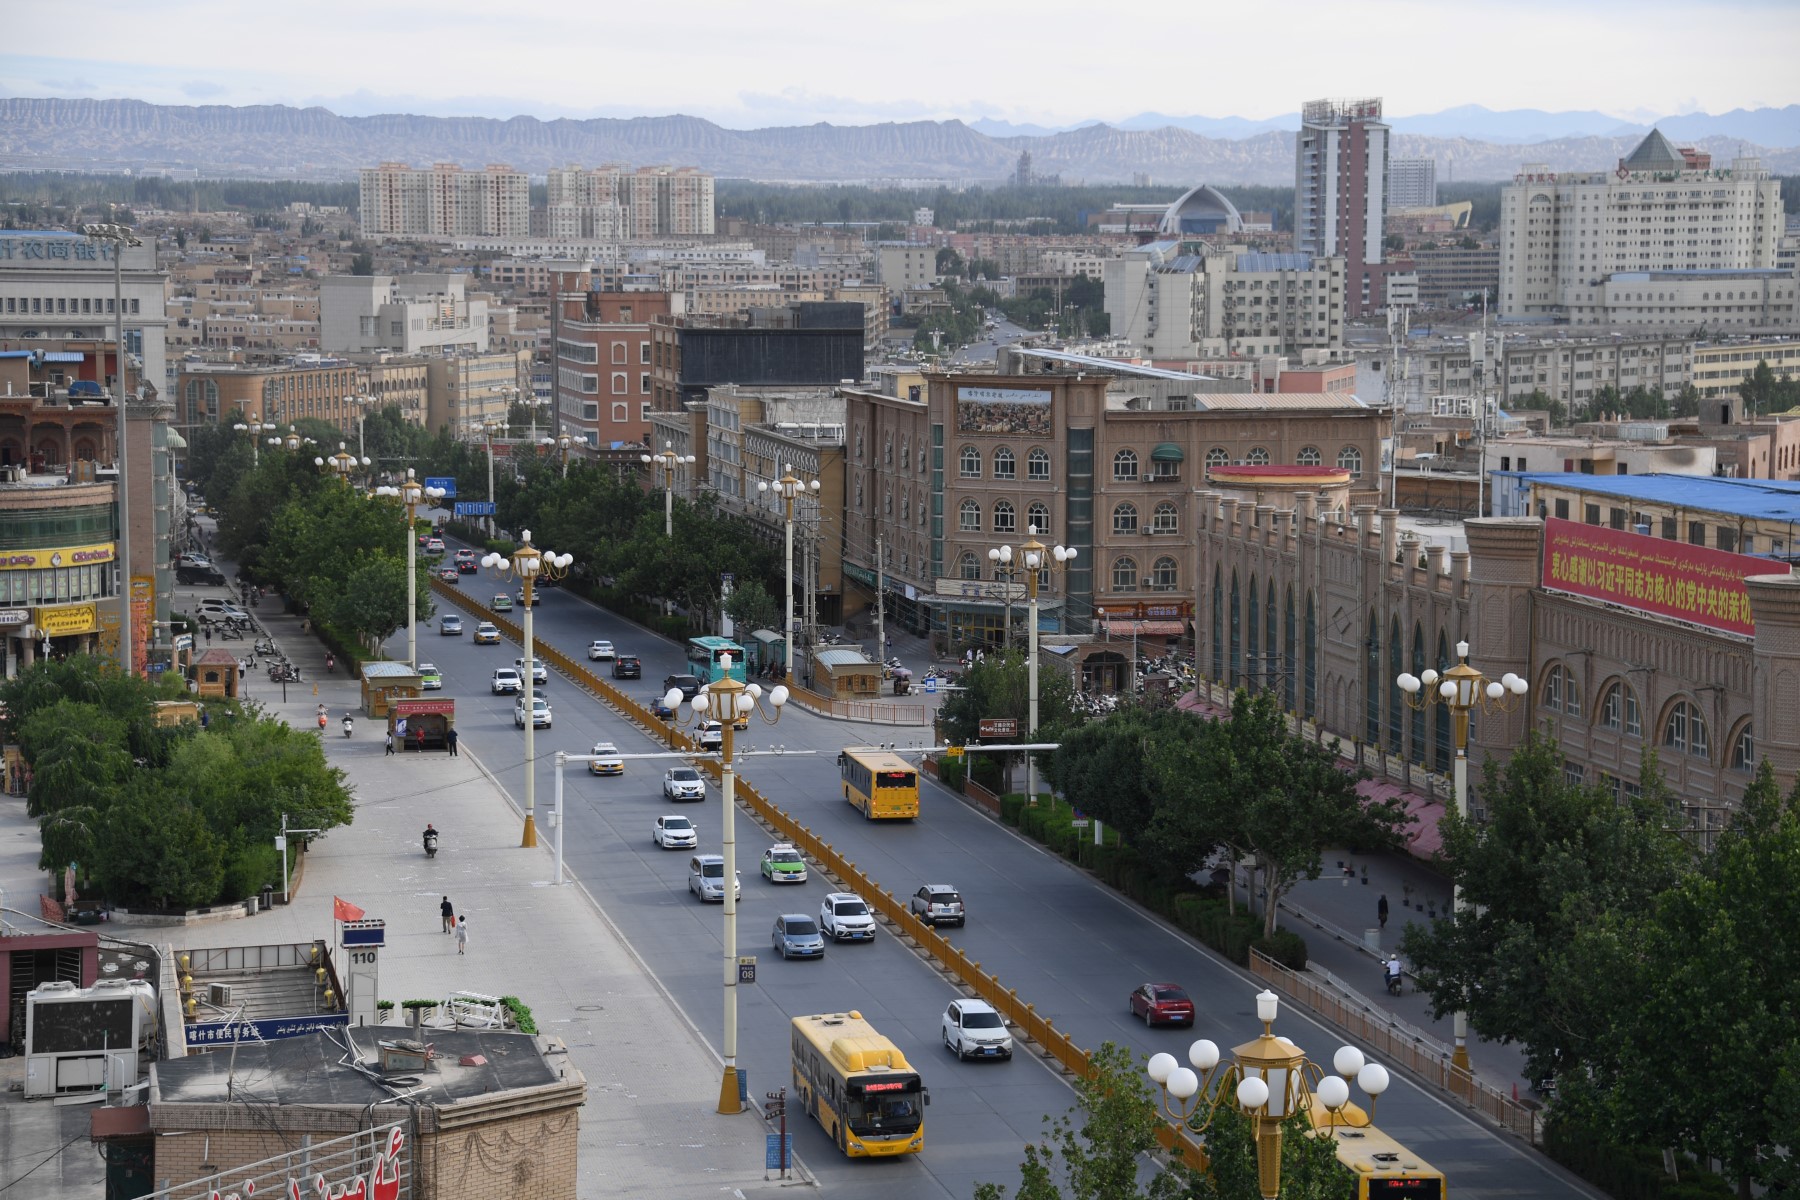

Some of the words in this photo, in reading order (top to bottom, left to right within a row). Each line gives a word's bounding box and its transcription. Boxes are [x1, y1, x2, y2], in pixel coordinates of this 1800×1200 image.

[1551, 551, 1755, 626] 衷心感谢以习近平同志为核心的党中央的亲切
[352, 952, 376, 964] 110
[742, 970, 754, 979] 08
